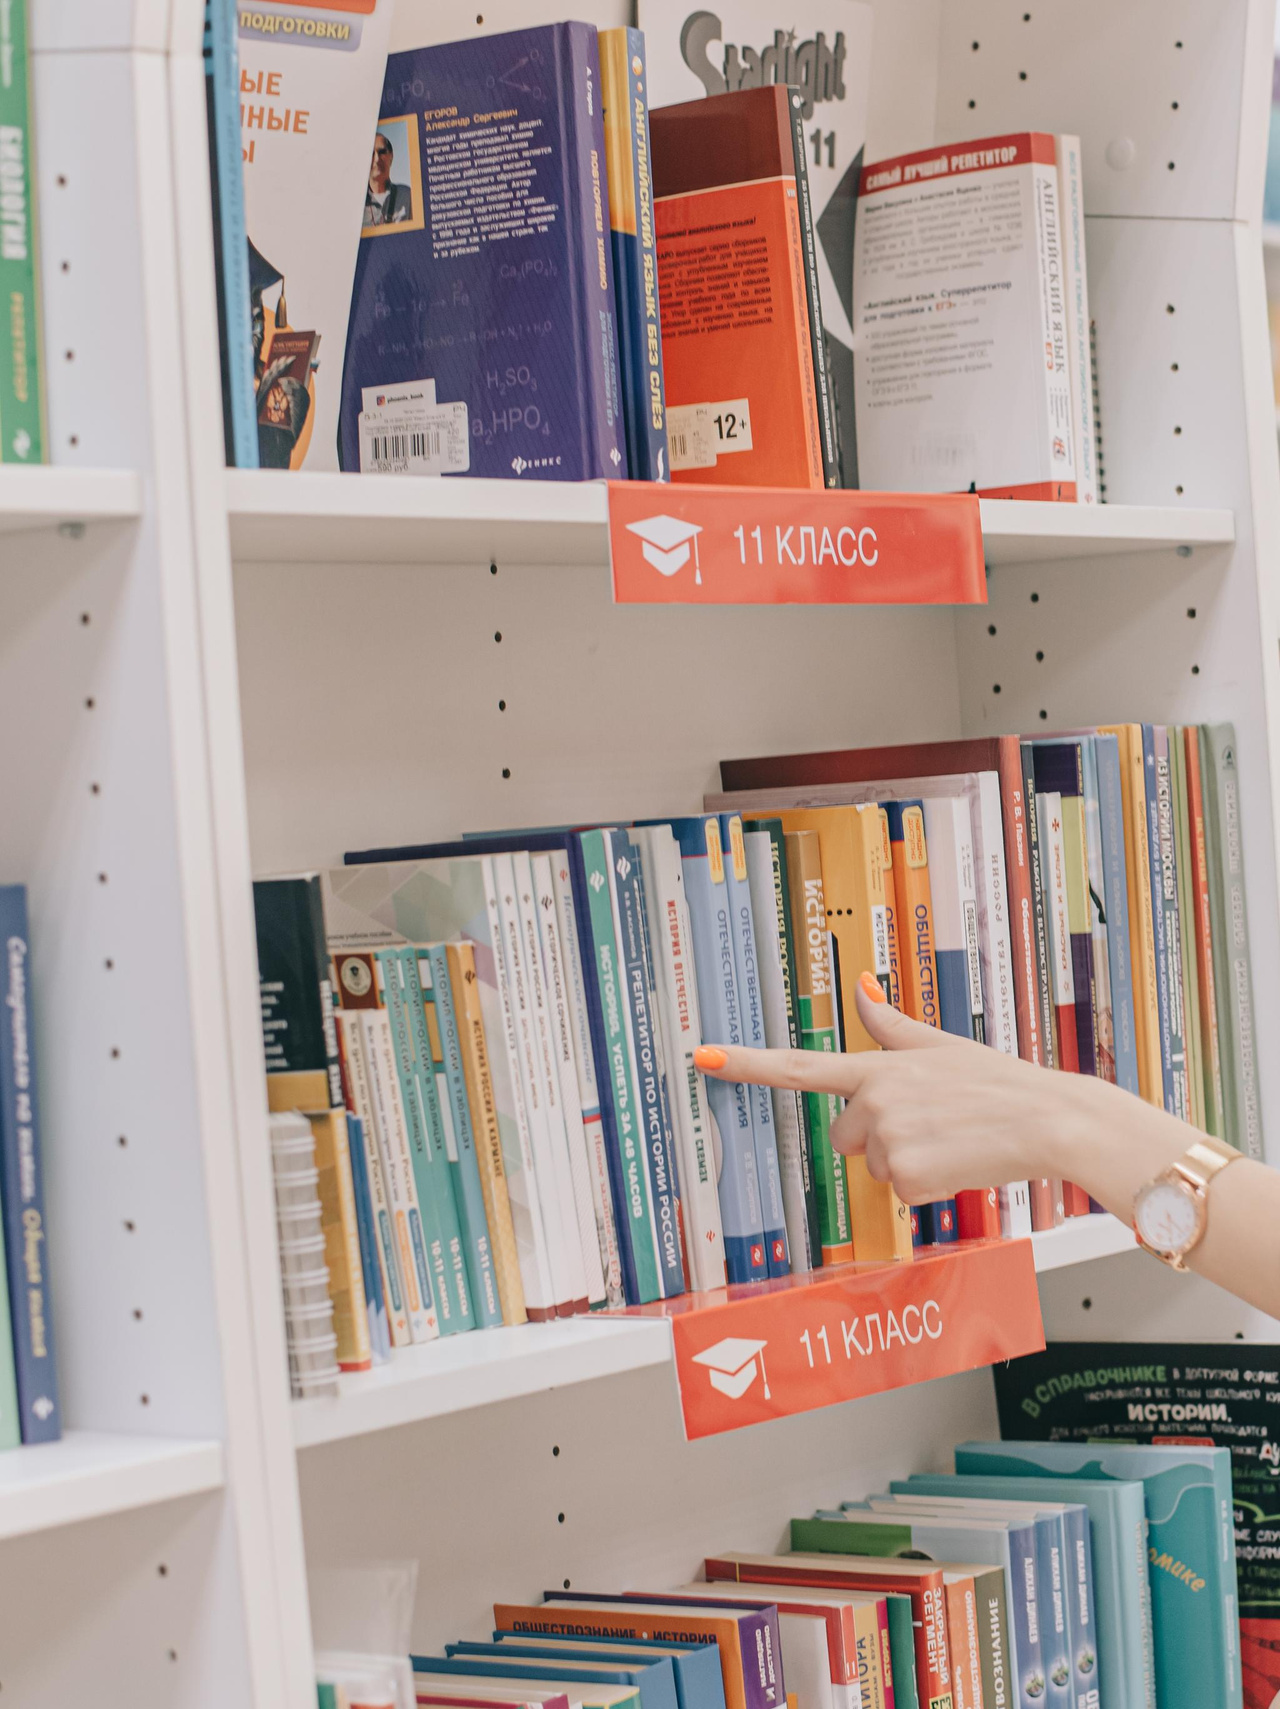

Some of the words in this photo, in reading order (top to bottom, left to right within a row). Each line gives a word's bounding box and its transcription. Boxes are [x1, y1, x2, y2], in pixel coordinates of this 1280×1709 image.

[240, 11, 350, 41] ПОДГОТОВКИ
[240, 69, 283, 96] ЫЕ
[424, 106, 458, 122] ЕГОРОВ
[425, 116, 471, 132] Александр
[473, 108, 518, 123] Сергеевич
[634, 97, 655, 249] АНГЛИЙСКИЙ
[810, 128, 836, 169] 11
[866, 166, 902, 191] САМЫЙ
[904, 155, 949, 181] ЛУЧШИЙ
[951, 146, 1018, 172] РЕПЕТИТОР
[590, 149, 604, 232] ПОВТОРЯЕМ
[597, 236, 608, 291] ХИМИЮ
[643, 253, 657, 319] ЯЗЫК
[940, 280, 1012, 299] Суперрепетитор
[1042, 179, 1064, 314] АНГЛИЙСКИЙ
[1053, 320, 1066, 374] ЯЗЫК
[647, 323, 659, 366] БЕЗ
[863, 313, 877, 324] для
[880, 306, 925, 320] подготовки
[1045, 341, 1054, 370] ЕГЭ
[471, 404, 550, 445] a2HPO4
[649, 370, 664, 431] СЛЁЗ
[713, 412, 748, 441] 12+
[733, 524, 765, 565] 11
[775, 525, 879, 568] КЛАСС
[1157, 756, 1168, 774] ИЗ
[1027, 778, 1038, 843] ИСТОРИЯ.
[1159, 775, 1172, 839] ИСТОРИИ
[771, 842, 787, 933] ИСТОРИЯ
[991, 854, 1003, 923] РОССИИ
[1032, 849, 1043, 902] РАБОТА
[1054, 842, 1062, 888] БЕЛЫЕ
[1161, 840, 1174, 900] МОСКВЫ
[667, 899, 683, 957] ИСТОРИЯ
[804, 880, 826, 997] ИСТОРИЯ
[875, 911, 887, 967] ИСТОРИЯ
[965, 907, 981, 1006] ОБЩЕСТВОЗНАНИЕ
[1059, 910, 1068, 970] КРАСНЫЕ
[546, 922, 563, 1000] ИСТОРИЧЕСКОЕ
[556, 1001, 571, 1063] СОЧИНЕНИЕ
[562, 894, 589, 1006] Историческое
[577, 1007, 595, 1085] сочинение
[599, 944, 621, 1038] ИСТОРИЯ.
[717, 908, 740, 1045] ОТЕЧЕСТВЕННАЯ
[740, 905, 762, 1042] ОТЕЧЕСТВЕННАЯ
[778, 936, 794, 1017] РОССИИ
[915, 904, 937, 1028] ОБЩЕСТВОЗ
[1021, 898, 1038, 1030] Обществознание
[631, 970, 654, 1075] РЕПЕТИТОР
[673, 963, 690, 1033] ОТЕЧЕСТВА
[387, 959, 401, 1020] ИСТОРИЯ
[396, 1023, 411, 1074] РОССИИ
[407, 1090, 423, 1153] таблицах
[405, 956, 420, 1019] ИСТОРИЯ
[415, 1020, 430, 1072] РОССИИ
[426, 1089, 443, 1151] таблицах
[435, 955, 451, 1017] ИСТОРИЯ
[445, 1020, 459, 1072] РОССИИ
[455, 1088, 471, 1151] таблицах
[611, 1042, 630, 1109] УСПЕТЬ
[473, 1019, 488, 1068] ИСТОРИЯ
[481, 1072, 493, 1114] РОССИИ
[488, 1127, 502, 1179] КАРМАНЕ
[644, 1076, 656, 1104] ПО
[686, 1064, 702, 1120] таблицах
[620, 1111, 633, 1135] ЗА
[624, 1136, 636, 1159] 48
[648, 1107, 667, 1193] ИСТОРИИ
[627, 1160, 643, 1219] ЧАСОВ
[694, 1139, 709, 1184] схемах
[658, 1196, 678, 1269] РОССИИ
[835, 1178, 848, 1240] ТАБЛИЦАХ
[432, 1239, 445, 1273] 10-11
[450, 1236, 462, 1269] 10-11
[456, 1272, 470, 1317] классы
[477, 1234, 489, 1267] 10-11
[483, 1270, 497, 1316] классы
[438, 1275, 452, 1320] классы
[799, 1324, 832, 1368] 11
[840, 1300, 943, 1360] КЛАСС
[1021, 1397, 1042, 1420] В
[1035, 1364, 1168, 1402] СПРАВОЧНИКЕ
[1172, 1367, 1181, 1381] В
[1243, 1367, 1279, 1384] ФОРМЕ
[1127, 1403, 1232, 1423] ИСТОРИИ.
[1023, 1557, 1035, 1600] АЛИХАН
[1050, 1547, 1061, 1590] АЛИХАН
[1076, 1540, 1087, 1582] АЛИХАН
[512, 1620, 636, 1639] ОБЩЕСТВОЗНАНИЕ
[652, 1630, 718, 1645] ИСТОРИЯ
[923, 1589, 939, 1675] СЕГМЕНТ
[1025, 1601, 1039, 1644] ДИНАЕВ
[1052, 1590, 1064, 1634] ДИНАЕВ
[1078, 1583, 1089, 1626] ДИНАЕВ
[755, 1628, 767, 1688] НАГЛЯДНО
[764, 1624, 776, 1684] ДОСТУПНО
[932, 1586, 950, 1685] ЗАКРЫТЫЙ
[988, 1597, 1006, 1709] ТВОЗНАНИЕ
